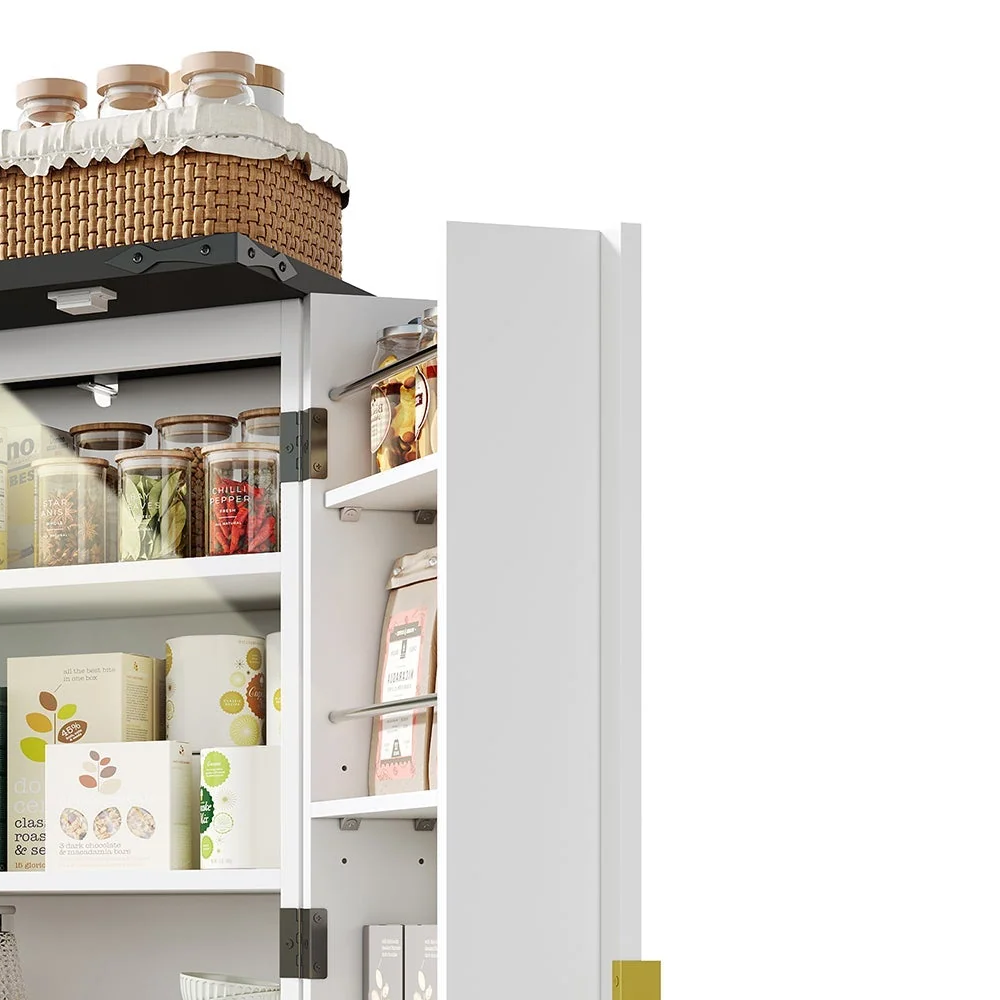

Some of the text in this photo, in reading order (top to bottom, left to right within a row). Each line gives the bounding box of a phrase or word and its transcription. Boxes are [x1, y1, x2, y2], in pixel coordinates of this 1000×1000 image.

[212, 485, 246, 494] CHILLI
[210, 495, 250, 504] PEPPER
[85, 841, 121, 849] chocolate
[14, 844, 28, 856] &
